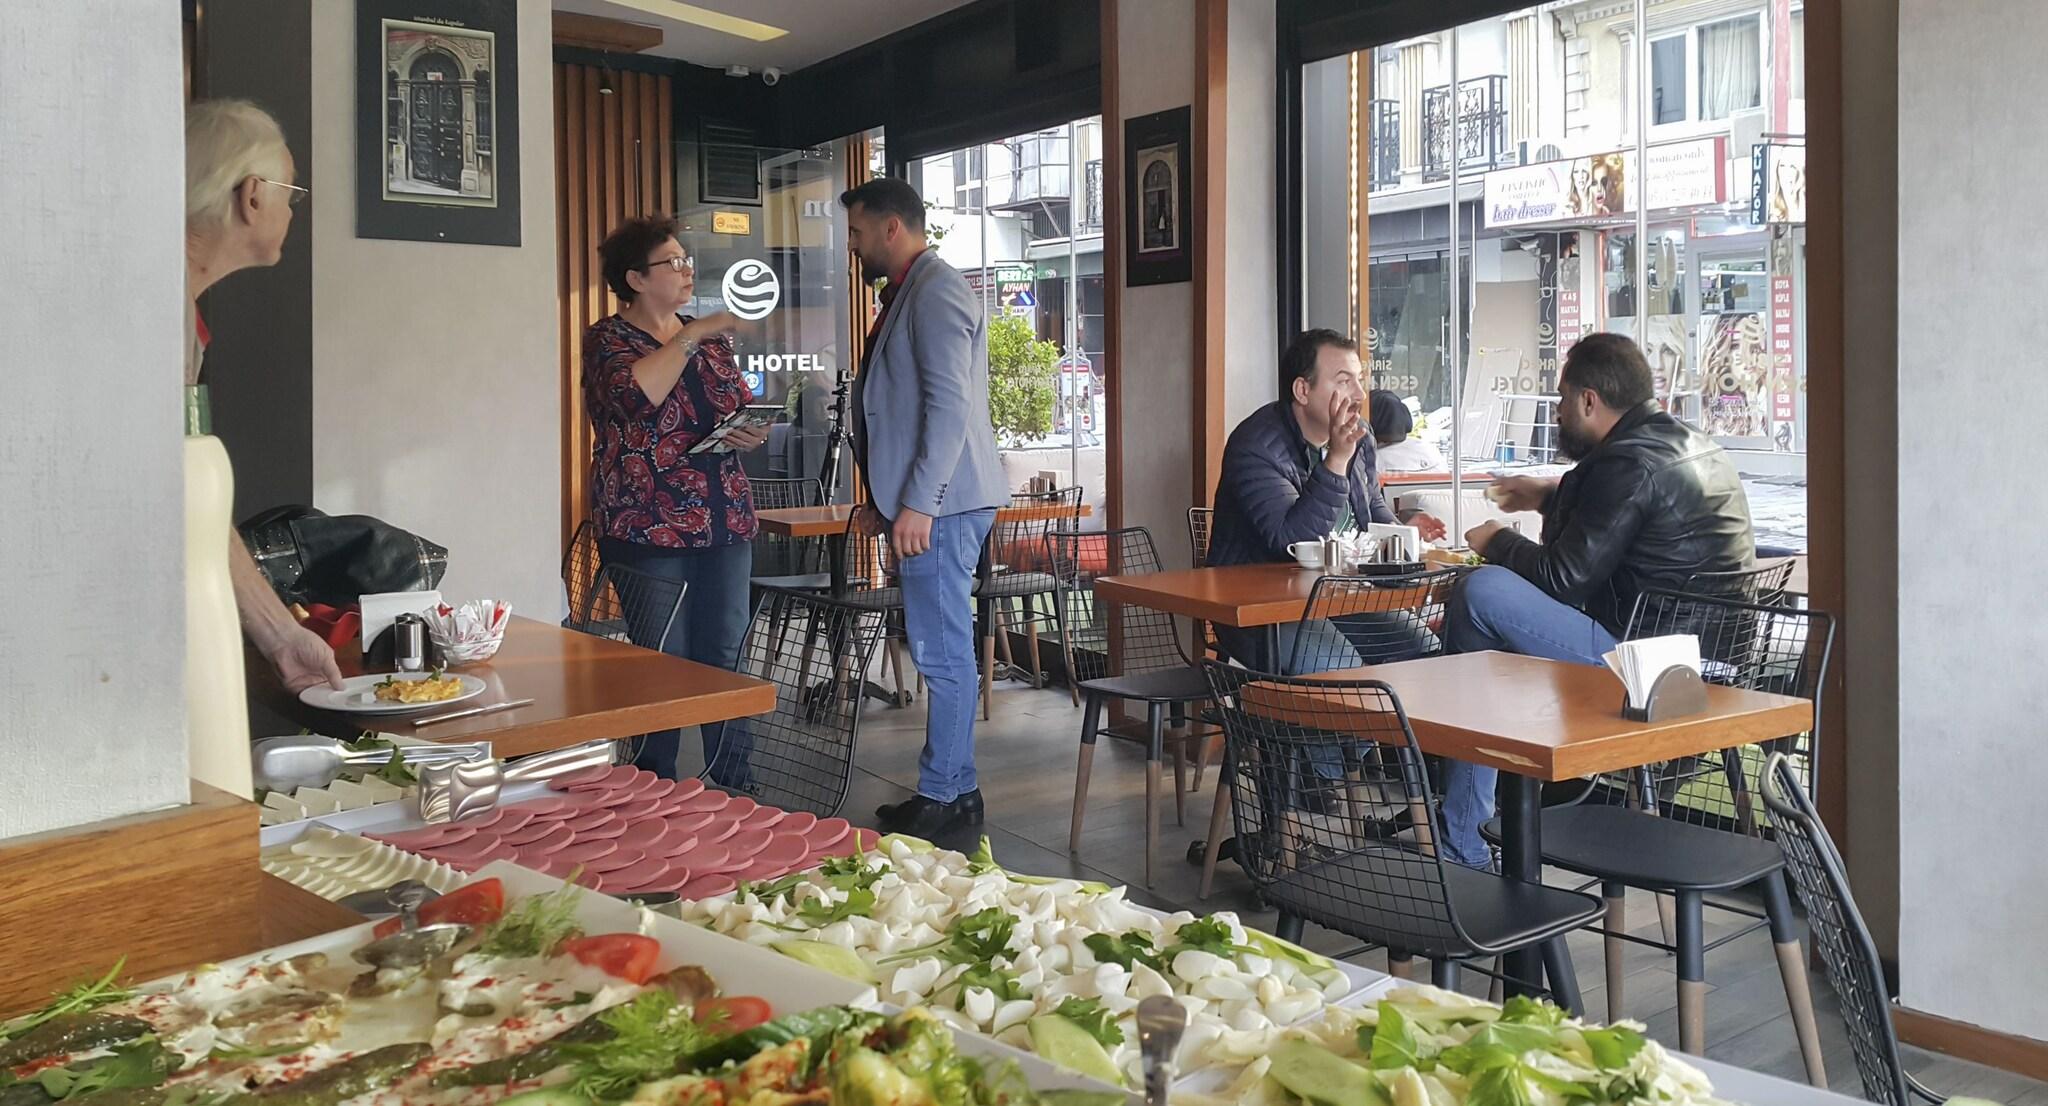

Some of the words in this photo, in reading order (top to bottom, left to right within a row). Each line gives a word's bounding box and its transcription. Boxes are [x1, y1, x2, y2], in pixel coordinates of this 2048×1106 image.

[1493, 203, 1517, 222] hair
[1518, 200, 1556, 219] dresser
[1002, 283, 1030, 293] AYHAN
[748, 354, 825, 372] HOTEL
